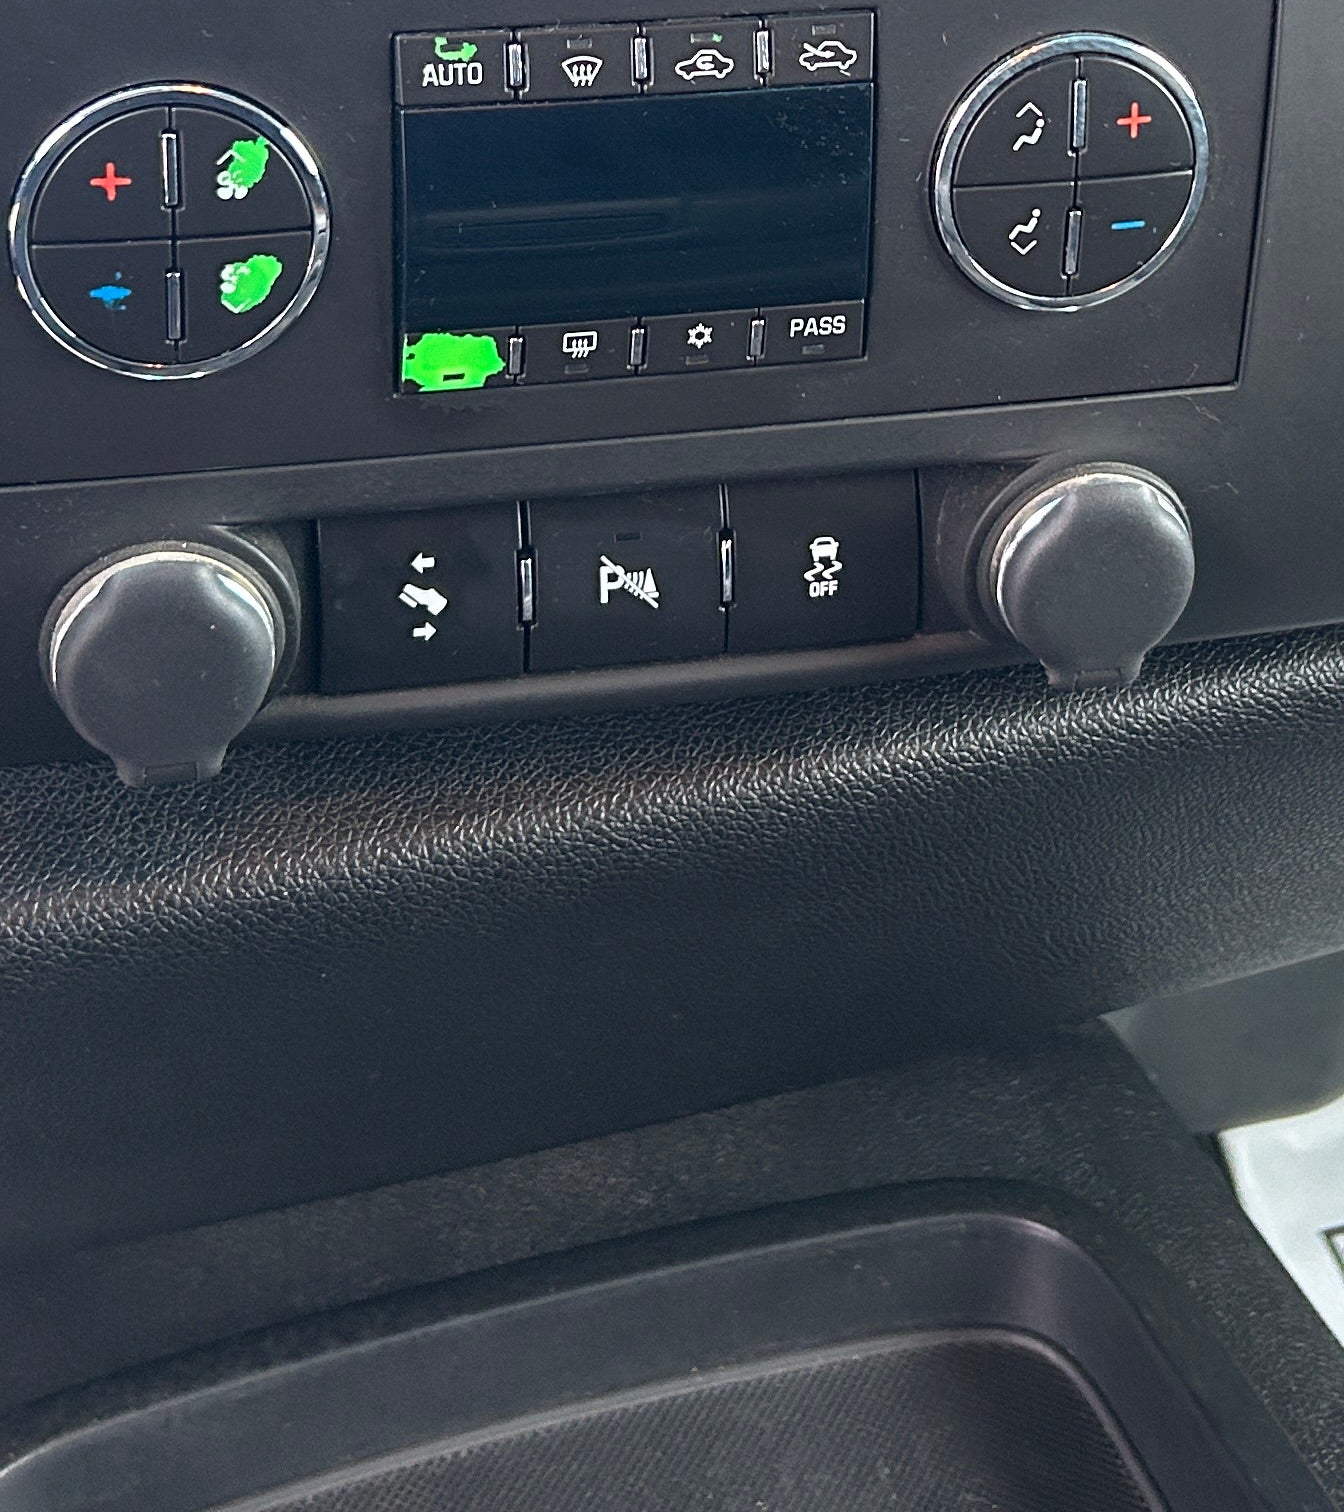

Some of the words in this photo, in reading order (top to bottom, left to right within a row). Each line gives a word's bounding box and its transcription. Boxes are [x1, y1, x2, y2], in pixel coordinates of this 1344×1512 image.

[421, 61, 484, 87] AUTO
[788, 314, 847, 338] PASS
[808, 579, 839, 598] OFF
